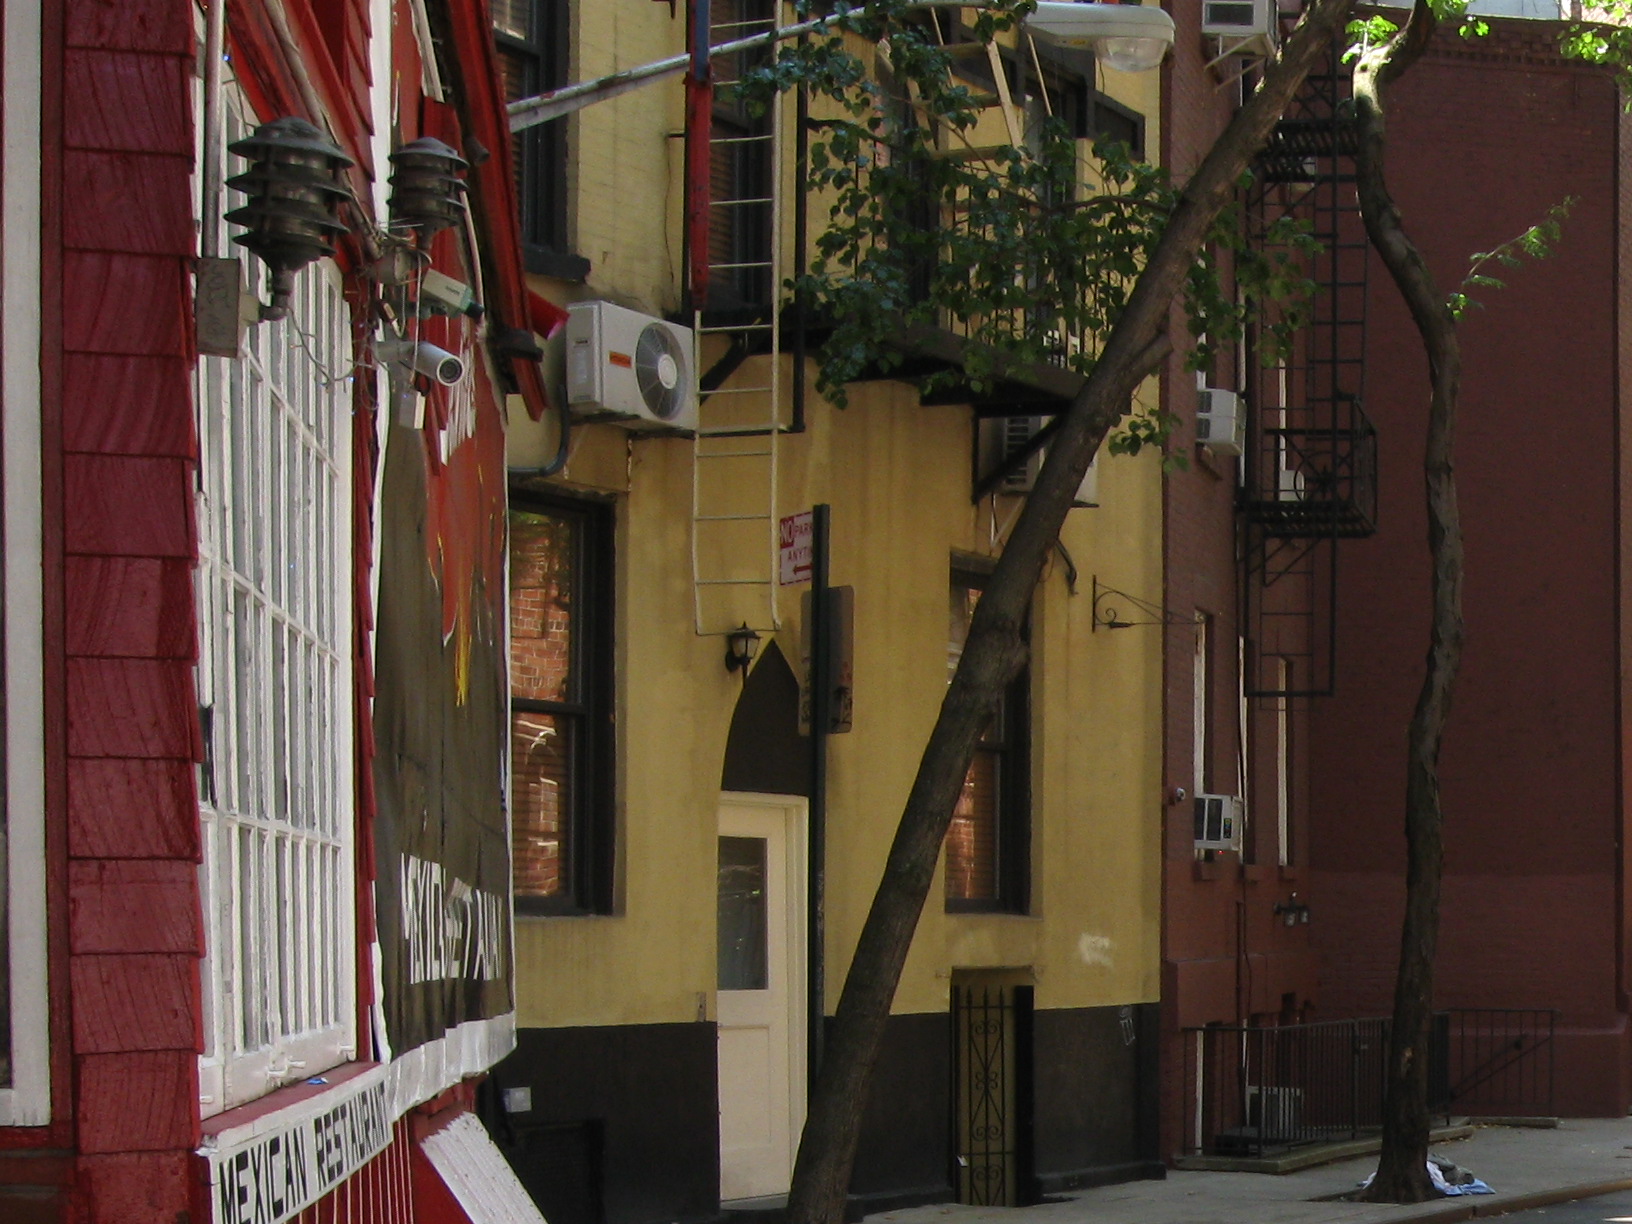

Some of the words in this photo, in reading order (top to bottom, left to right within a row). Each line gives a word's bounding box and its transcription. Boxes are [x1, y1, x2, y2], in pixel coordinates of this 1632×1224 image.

[781, 520, 795, 544] NO
[794, 521, 812, 537] PARK
[313, 1079, 390, 1192] RESTAURANT
